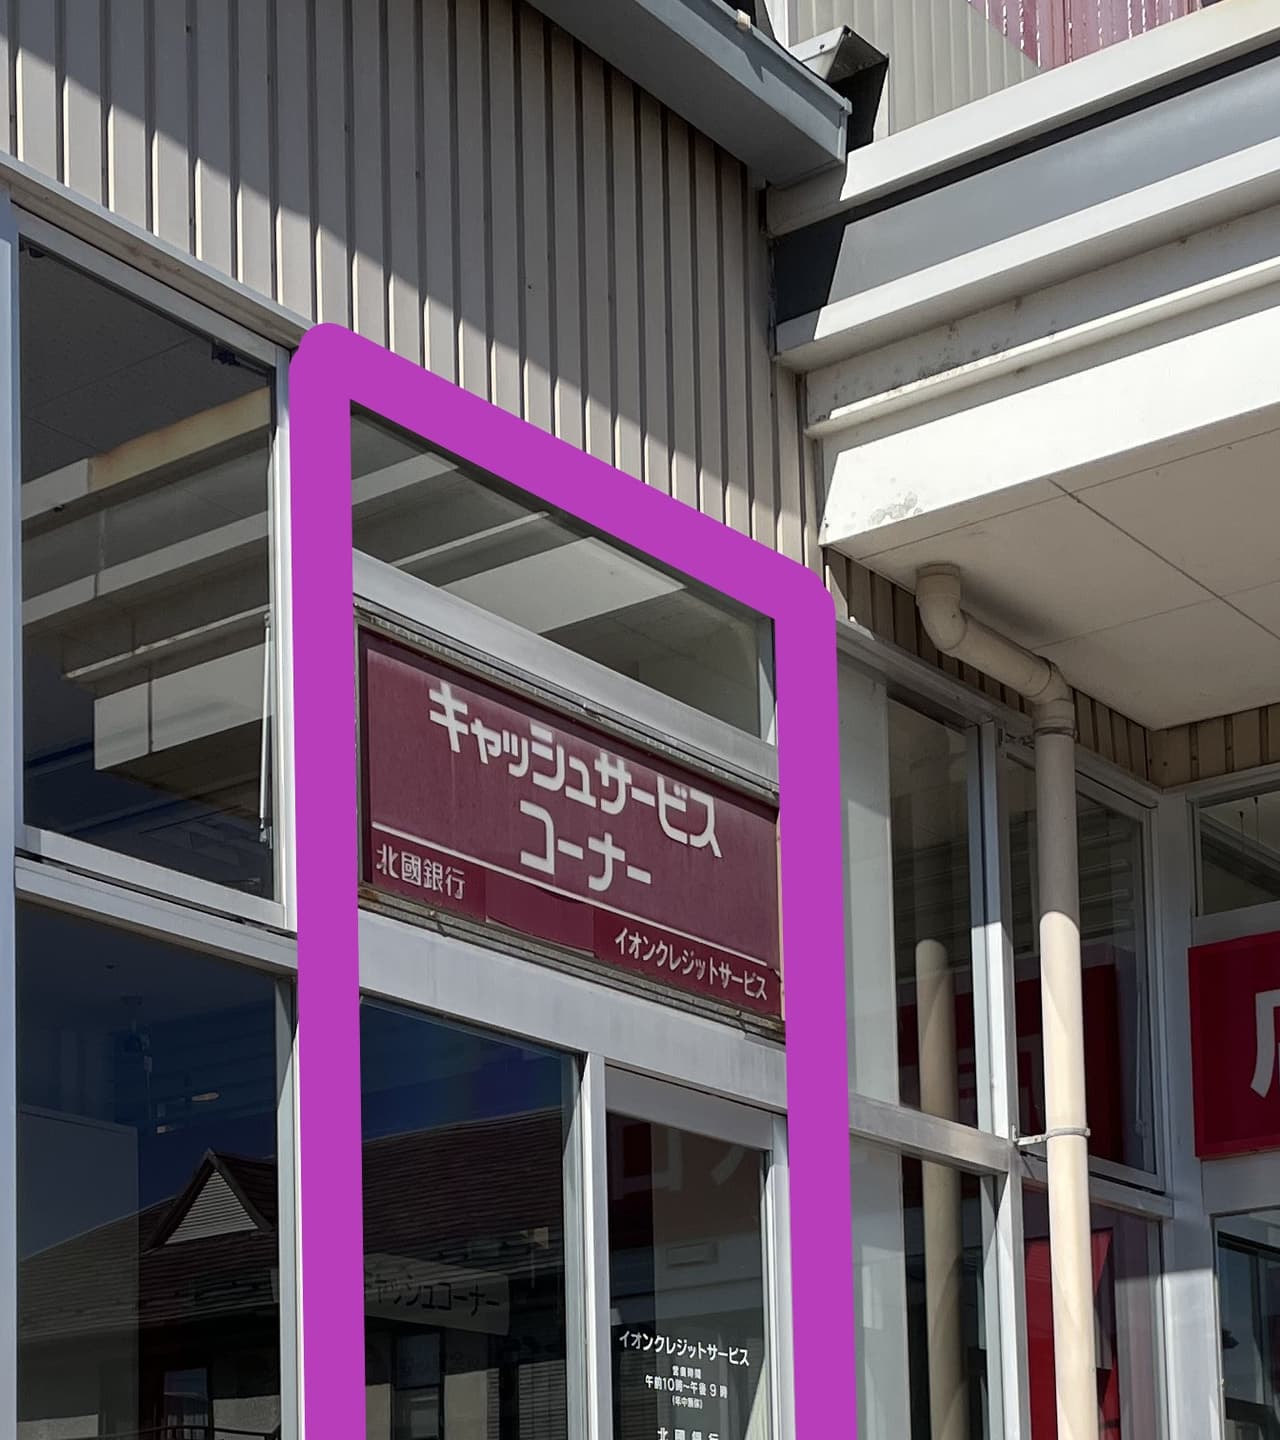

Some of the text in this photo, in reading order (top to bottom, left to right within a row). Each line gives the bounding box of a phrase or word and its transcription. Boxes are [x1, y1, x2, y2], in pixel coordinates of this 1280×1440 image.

[428, 682, 722, 858] キャッシュサービス
[376, 844, 465, 899] 北國銀行
[520, 800, 652, 891] コーナー
[615, 927, 768, 1000] イオンクレジットサービス
[619, 1331, 750, 1366] イオンクレジットサービス
